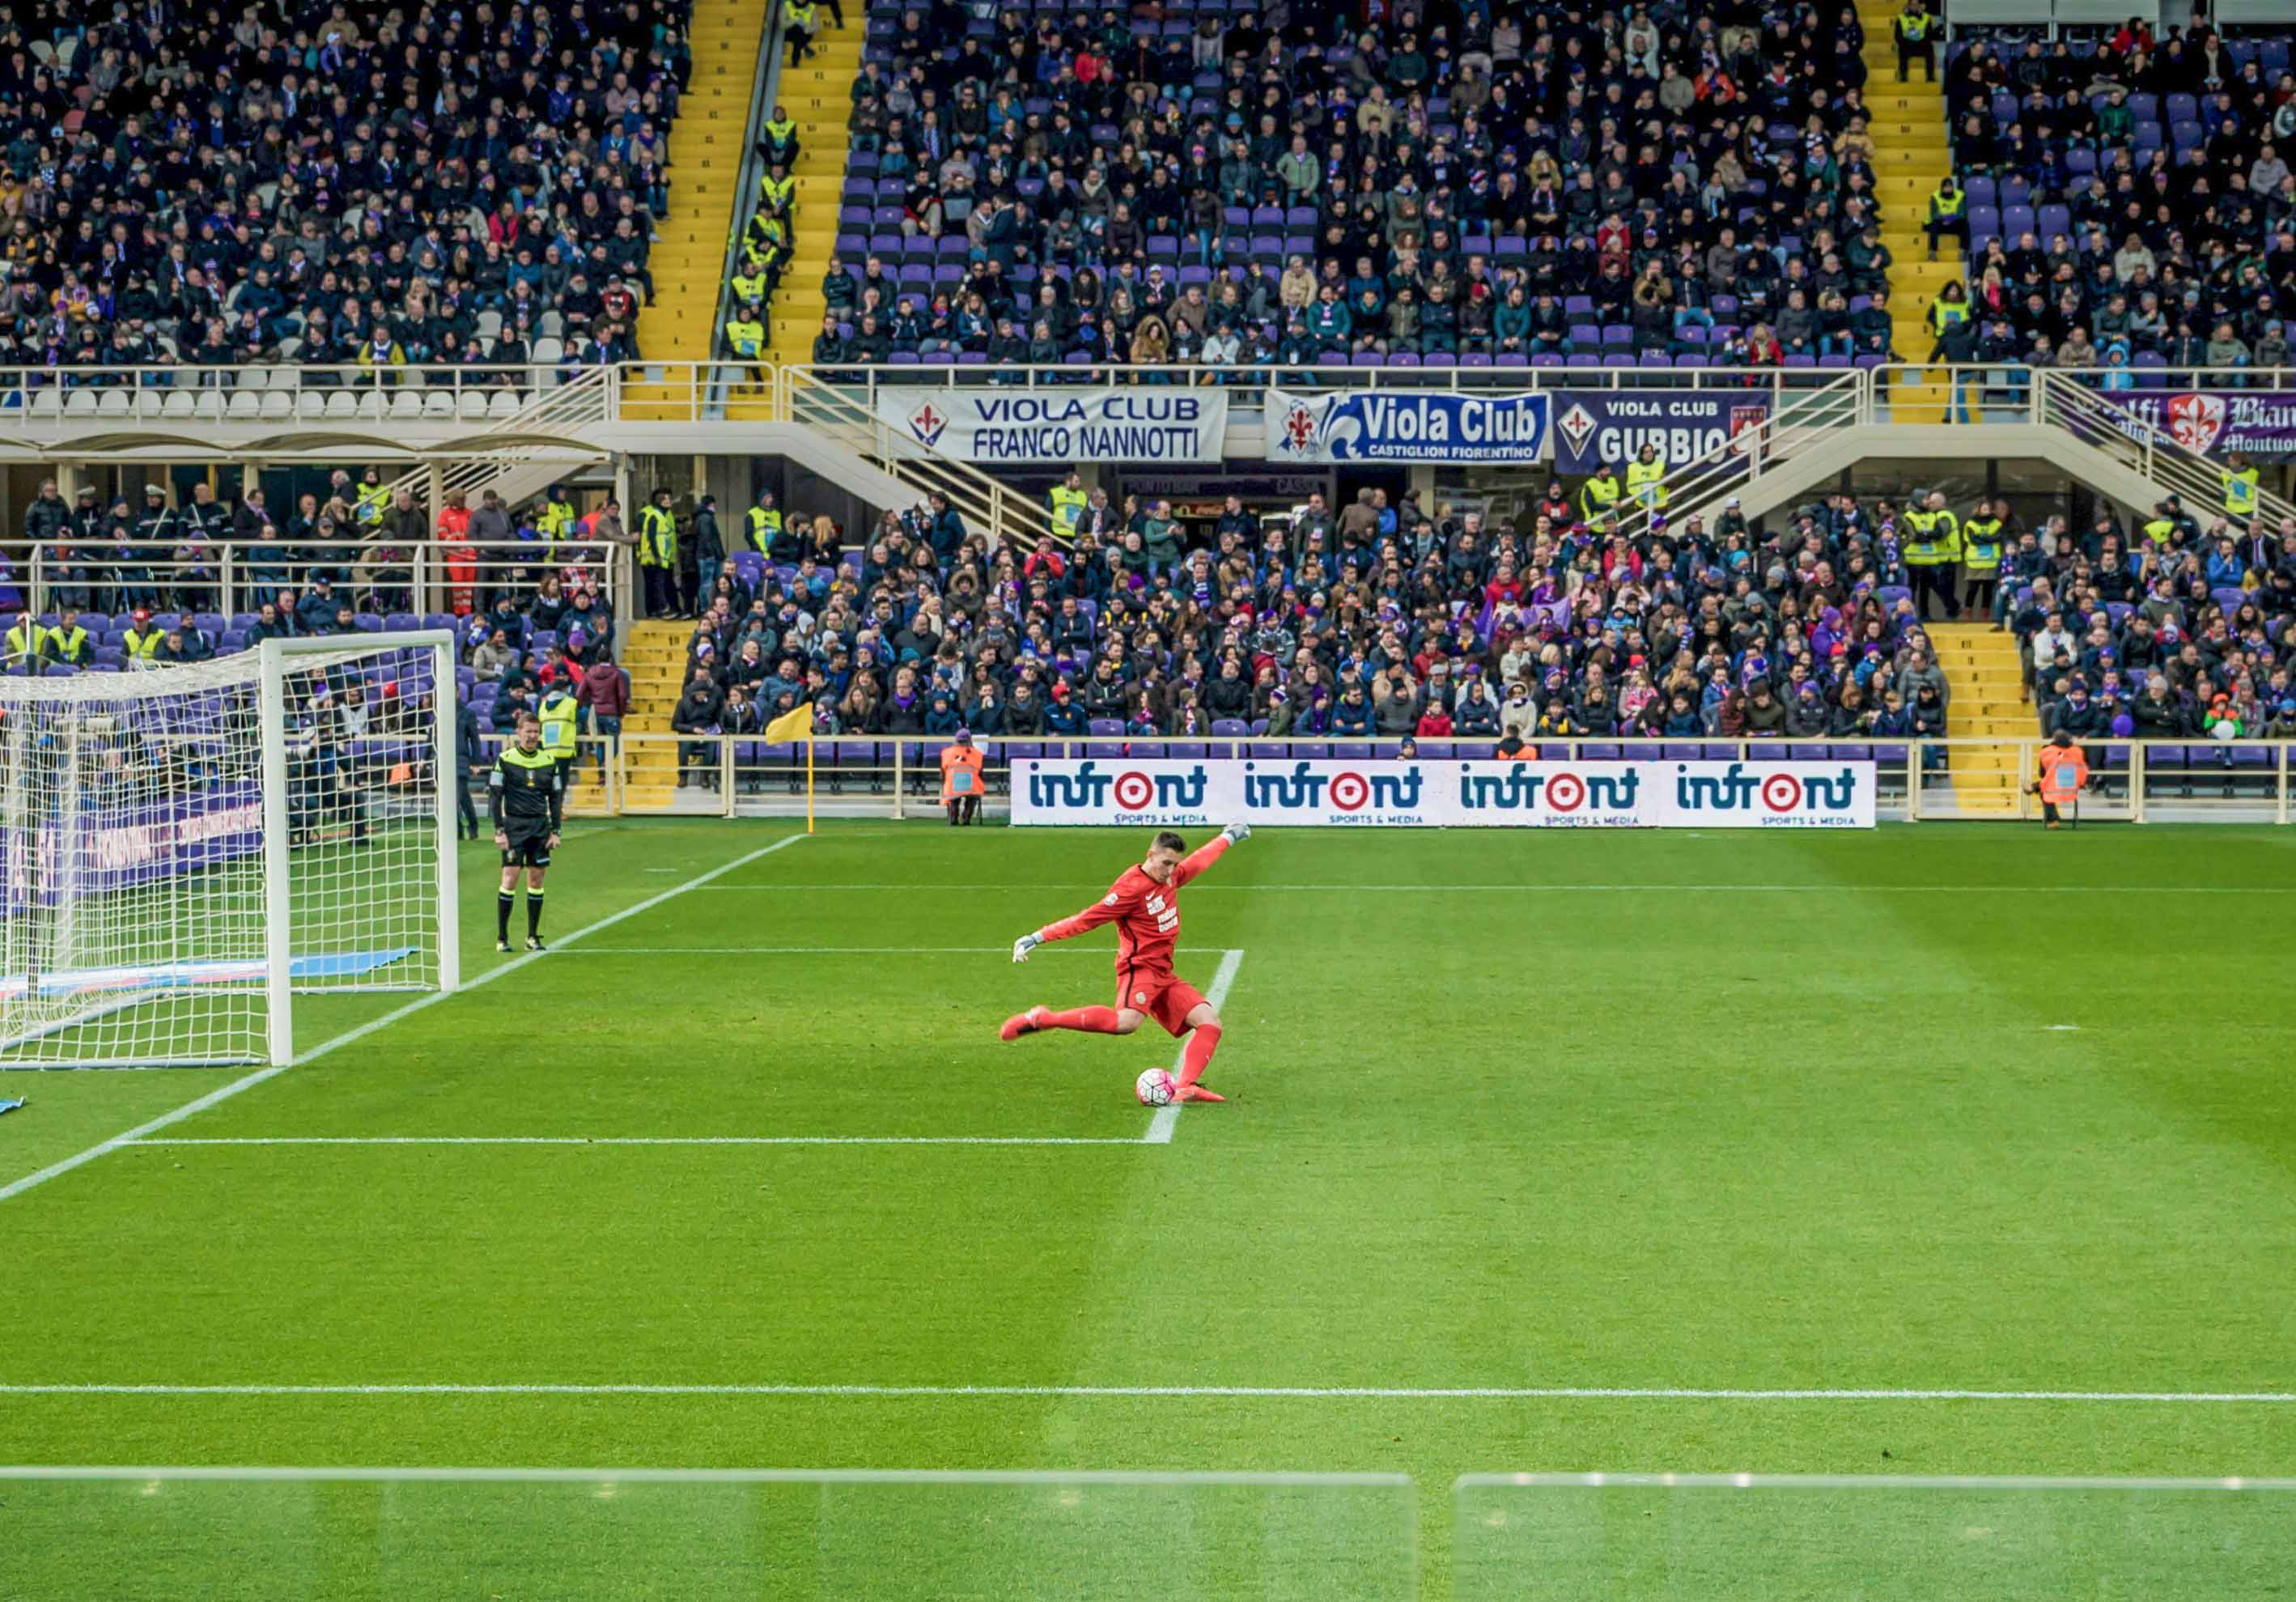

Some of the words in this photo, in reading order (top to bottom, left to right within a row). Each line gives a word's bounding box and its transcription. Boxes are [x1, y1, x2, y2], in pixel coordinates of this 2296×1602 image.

[974, 398, 1087, 423] VIOLA
[1101, 397, 1199, 421] CLUB
[1361, 397, 1447, 441] Viola
[1459, 397, 1537, 442] Club
[1606, 402, 1662, 417] VIOLA
[1669, 402, 1718, 417] CLUB
[974, 427, 1071, 458] FRANCO
[1080, 426, 1199, 458] NANNOTTI
[1368, 445, 1449, 459] CASTIGLION
[1451, 446, 1534, 460] FIORENTINO
[1599, 427, 1726, 464] GUBBIO
[1030, 761, 1207, 810] infront
[1245, 762, 1424, 810] infront
[1461, 763, 1640, 811] infront
[1677, 763, 1857, 812] infront
[1114, 813, 1156, 823] SPORTS
[1173, 814, 1207, 824] MEDIA
[1330, 814, 1371, 824] SPORTS
[1387, 815, 1423, 824] MEDIA
[1544, 815, 1588, 826] SPORTS
[1603, 815, 1640, 825] MEDIA
[1761, 816, 1805, 826] SPORTS
[1820, 817, 1857, 826] MEDIA
